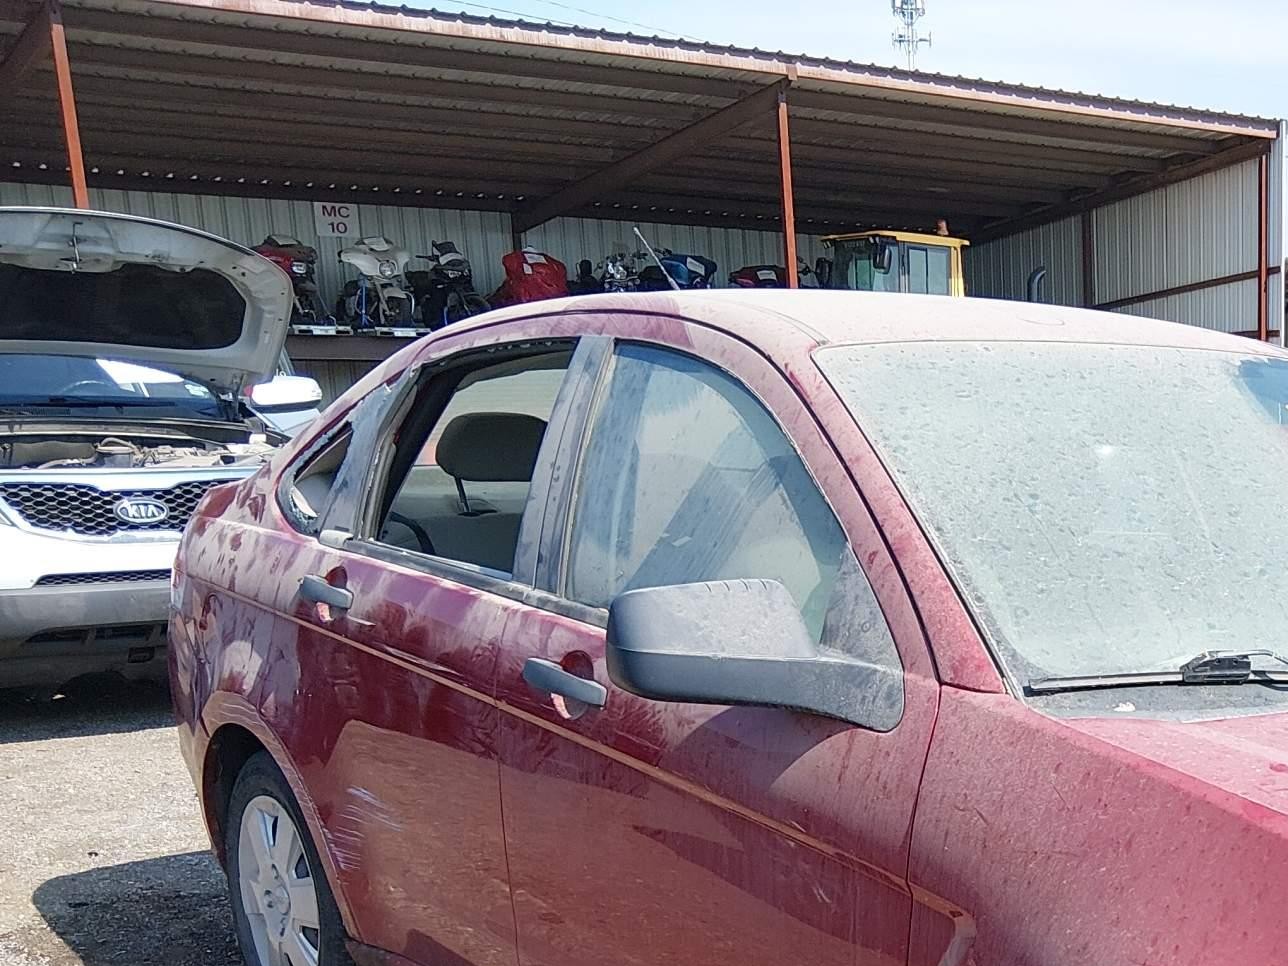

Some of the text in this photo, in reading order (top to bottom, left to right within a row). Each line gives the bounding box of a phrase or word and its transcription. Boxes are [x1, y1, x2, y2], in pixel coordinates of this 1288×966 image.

[321, 204, 351, 218] MC
[327, 221, 348, 234] 10
[125, 503, 160, 519] KIA
